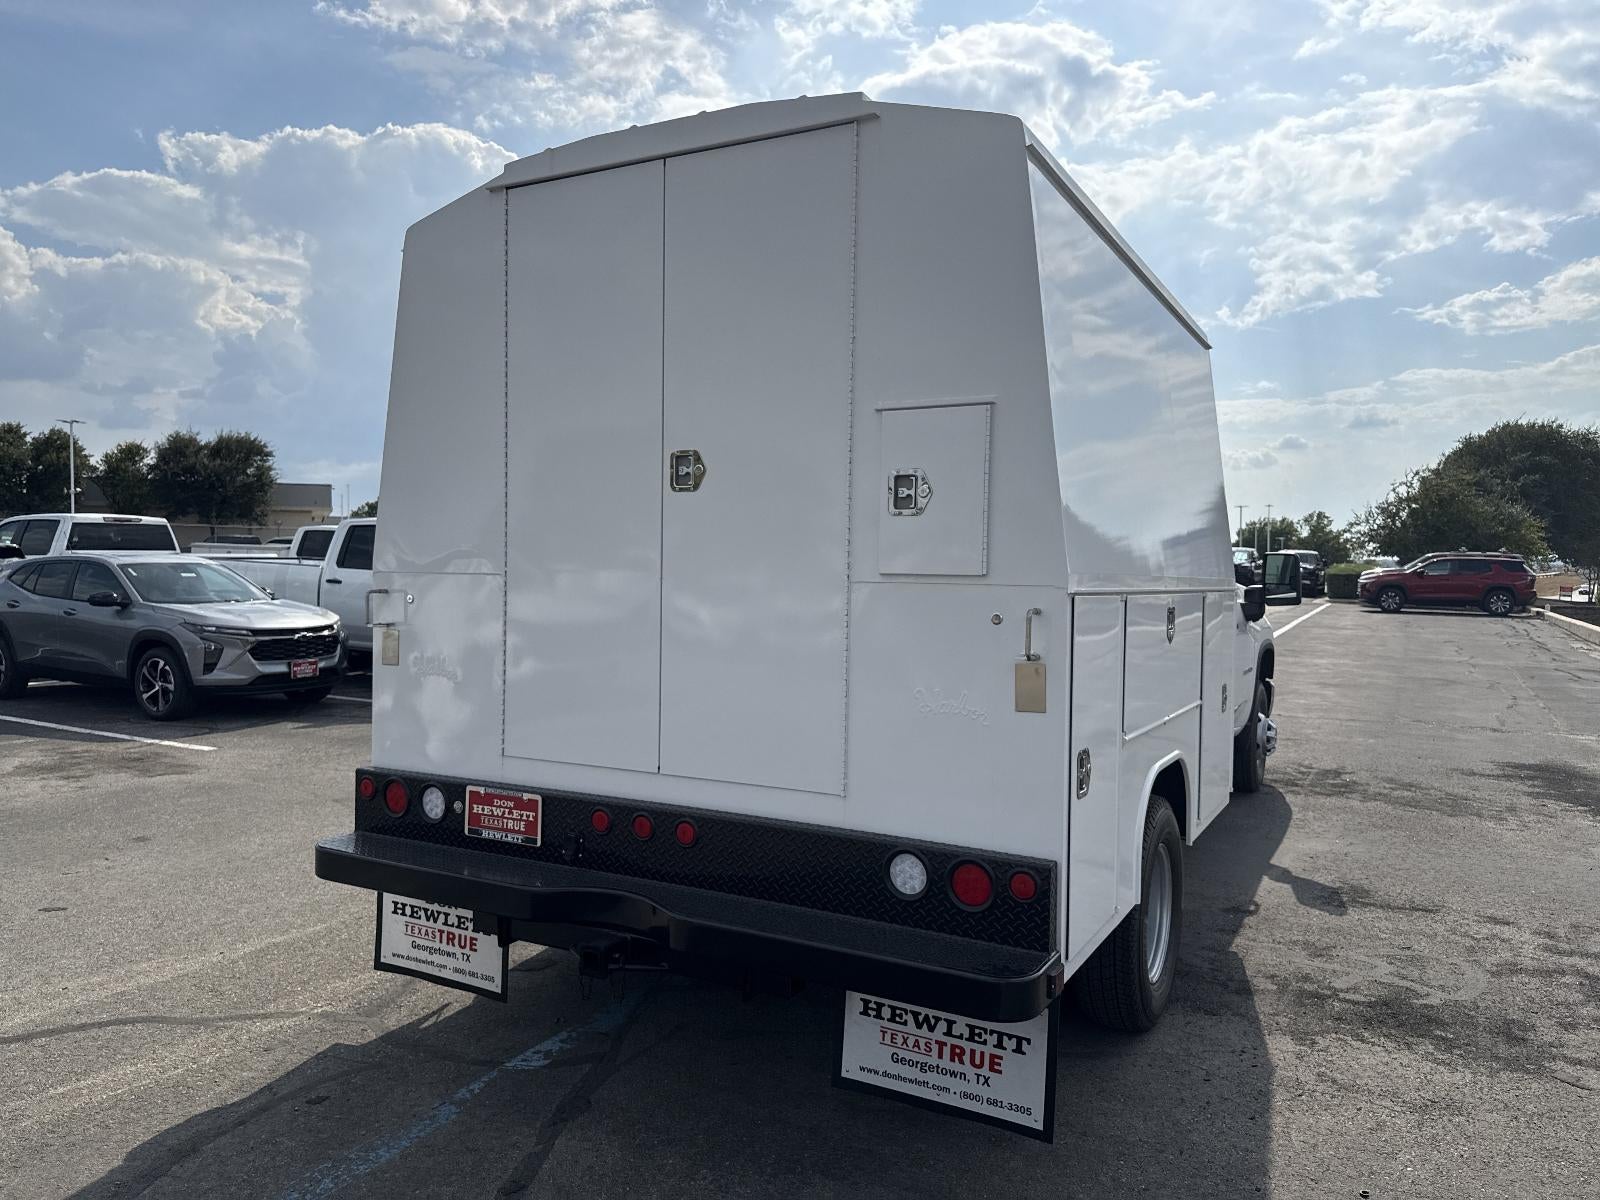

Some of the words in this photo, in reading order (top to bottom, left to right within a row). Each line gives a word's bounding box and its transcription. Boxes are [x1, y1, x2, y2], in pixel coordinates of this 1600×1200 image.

[472, 804, 536, 821] HEWLETT
[493, 799, 515, 809] DON
[481, 829, 524, 843] HEWLETT
[391, 900, 474, 931] HEWLE
[411, 940, 459, 961] Georgetown,
[461, 952, 471, 964] TX
[391, 952, 448, 971] www.donhewlett.com
[452, 966, 467, 978] (800)
[468, 970, 496, 984] 681-3305
[859, 997, 1032, 1056] HEWLETT
[891, 1052, 971, 1085] Georgetown,
[974, 1072, 992, 1088] TX
[858, 1065, 951, 1094] www.donhewlett.com
[959, 1090, 984, 1106] (800)
[986, 1096, 1032, 1117] 681-3305
